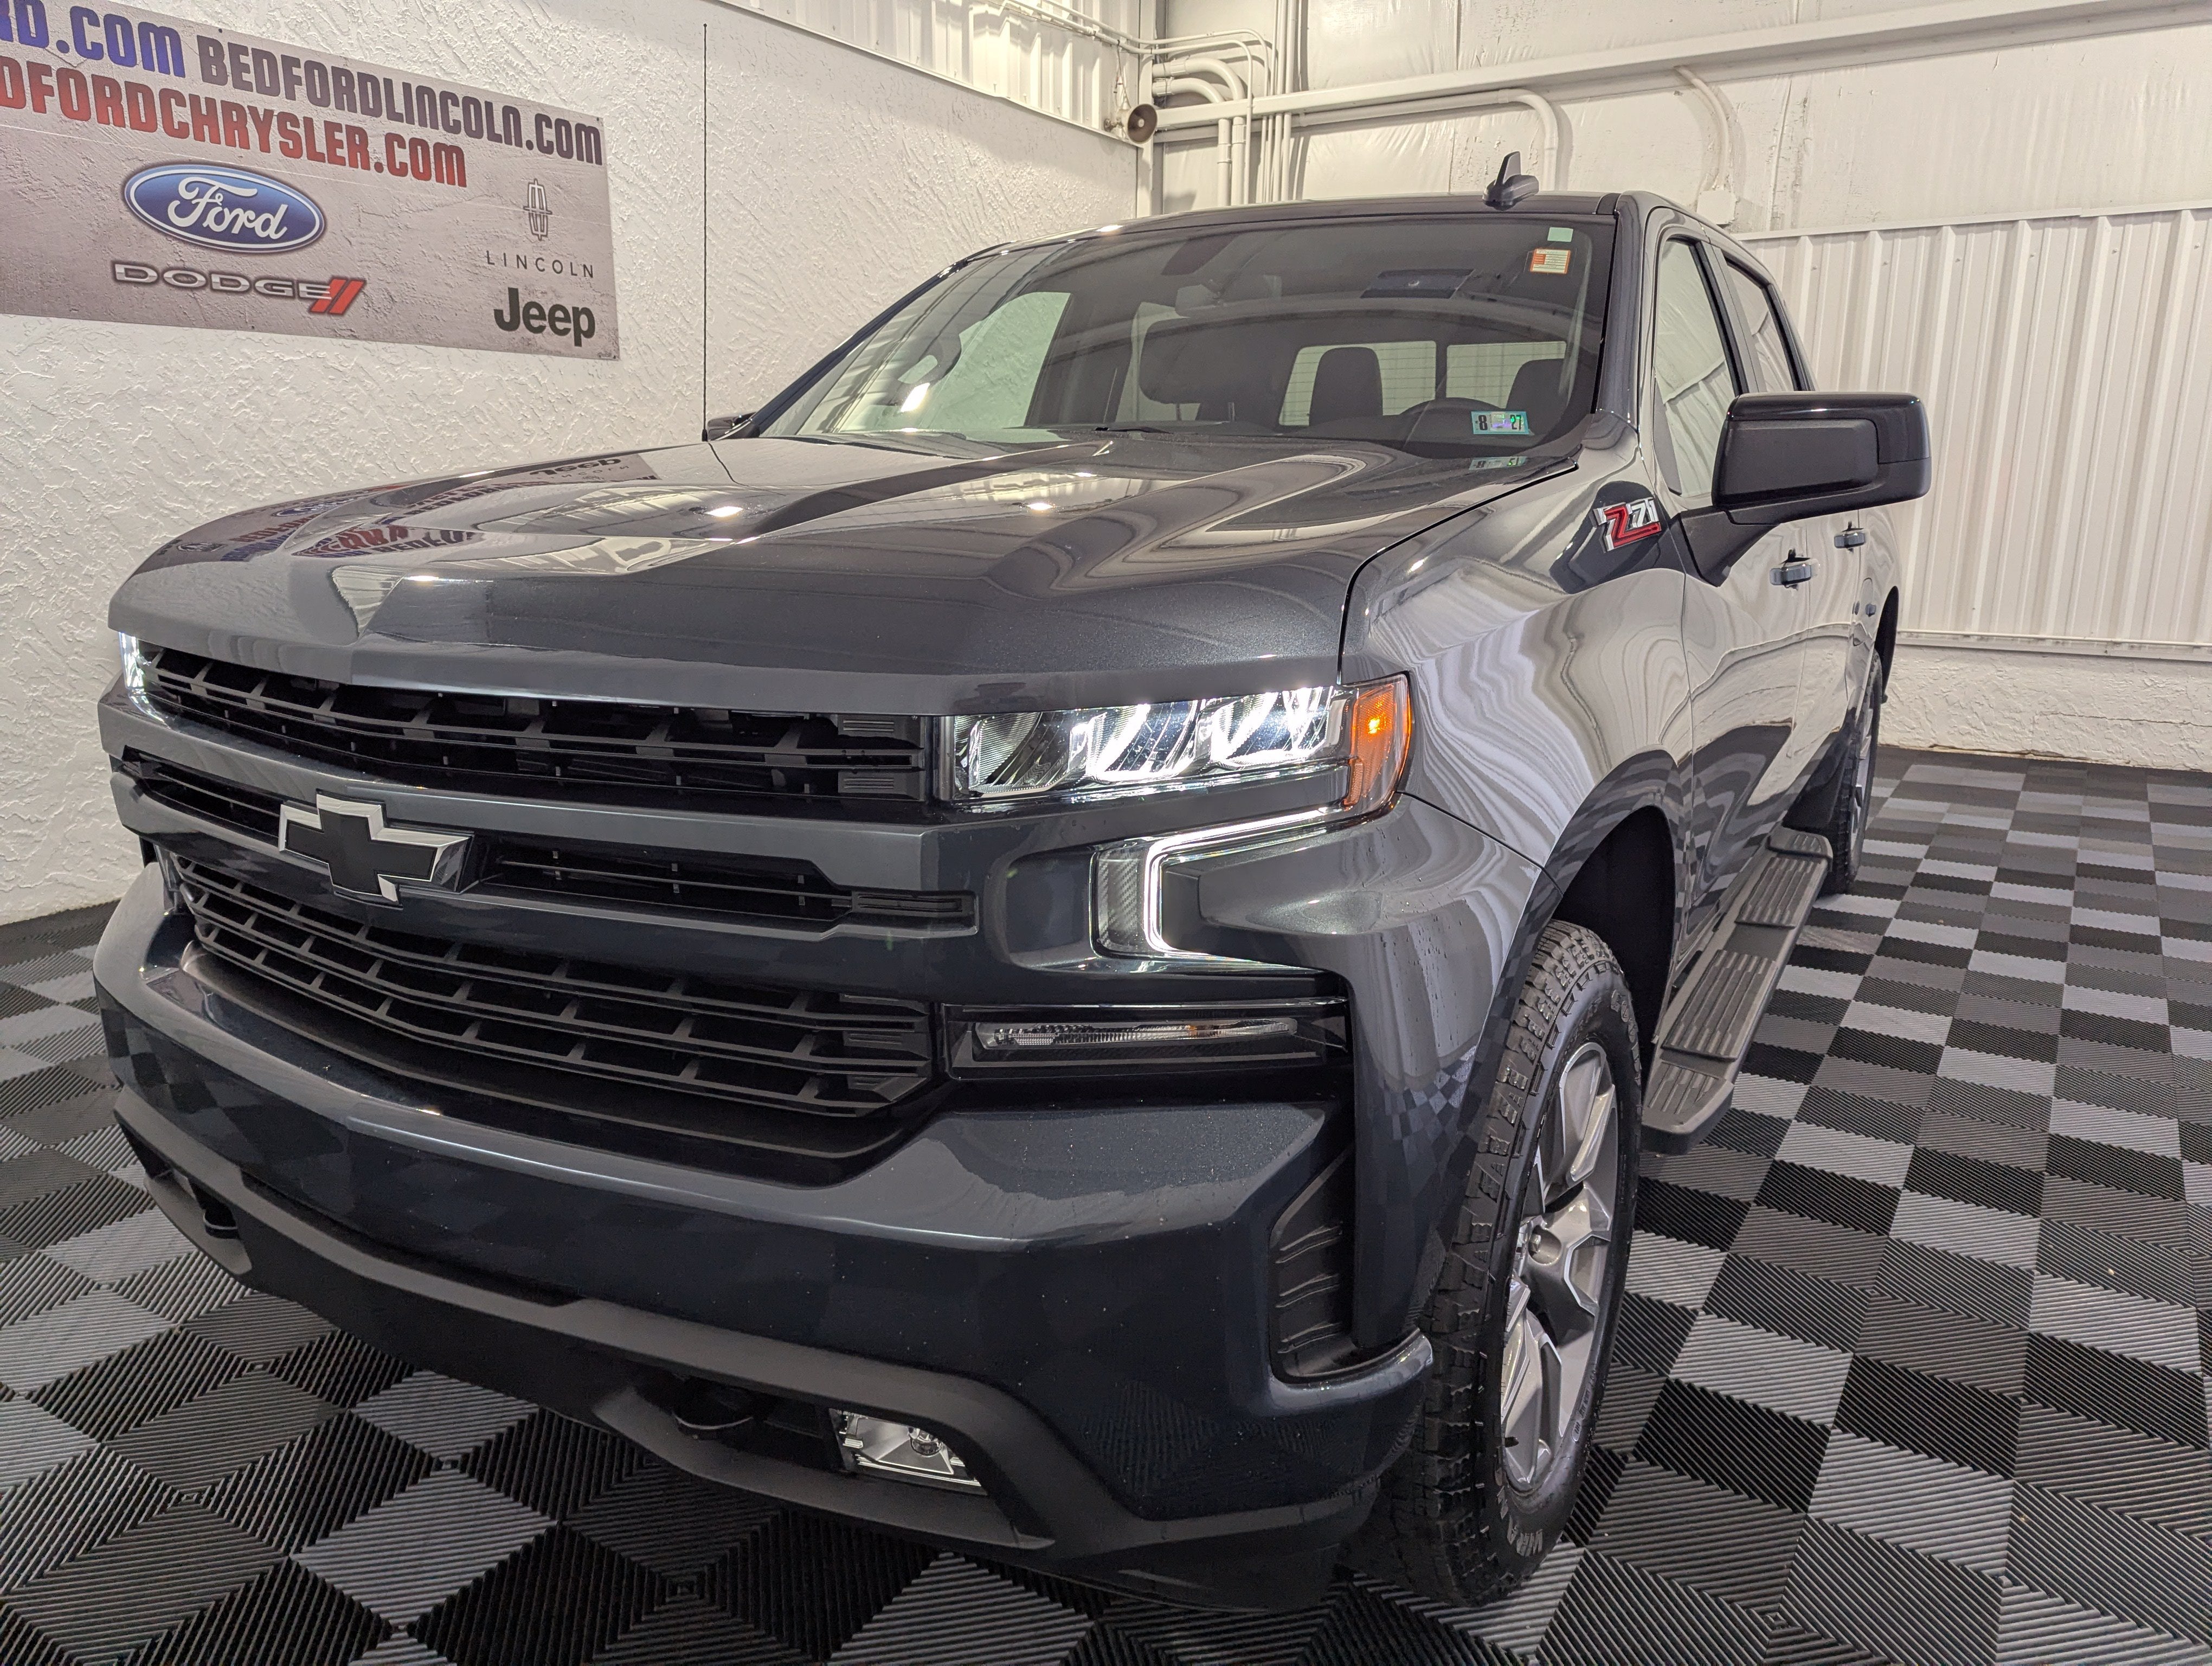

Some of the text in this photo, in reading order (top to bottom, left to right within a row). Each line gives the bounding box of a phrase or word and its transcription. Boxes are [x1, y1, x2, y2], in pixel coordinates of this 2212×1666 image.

[0, 56, 467, 188] DFORDCHRYSLER.COM
[197, 35, 602, 165] BEDFORDLINCOLN.COM
[168, 177, 288, 239] Ford
[115, 264, 332, 300] DODGE
[486, 251, 593, 278] LINCOLN
[493, 287, 595, 347] Jeep
[1478, 415, 1521, 431] 8 27
[1593, 497, 1661, 553] Z71
